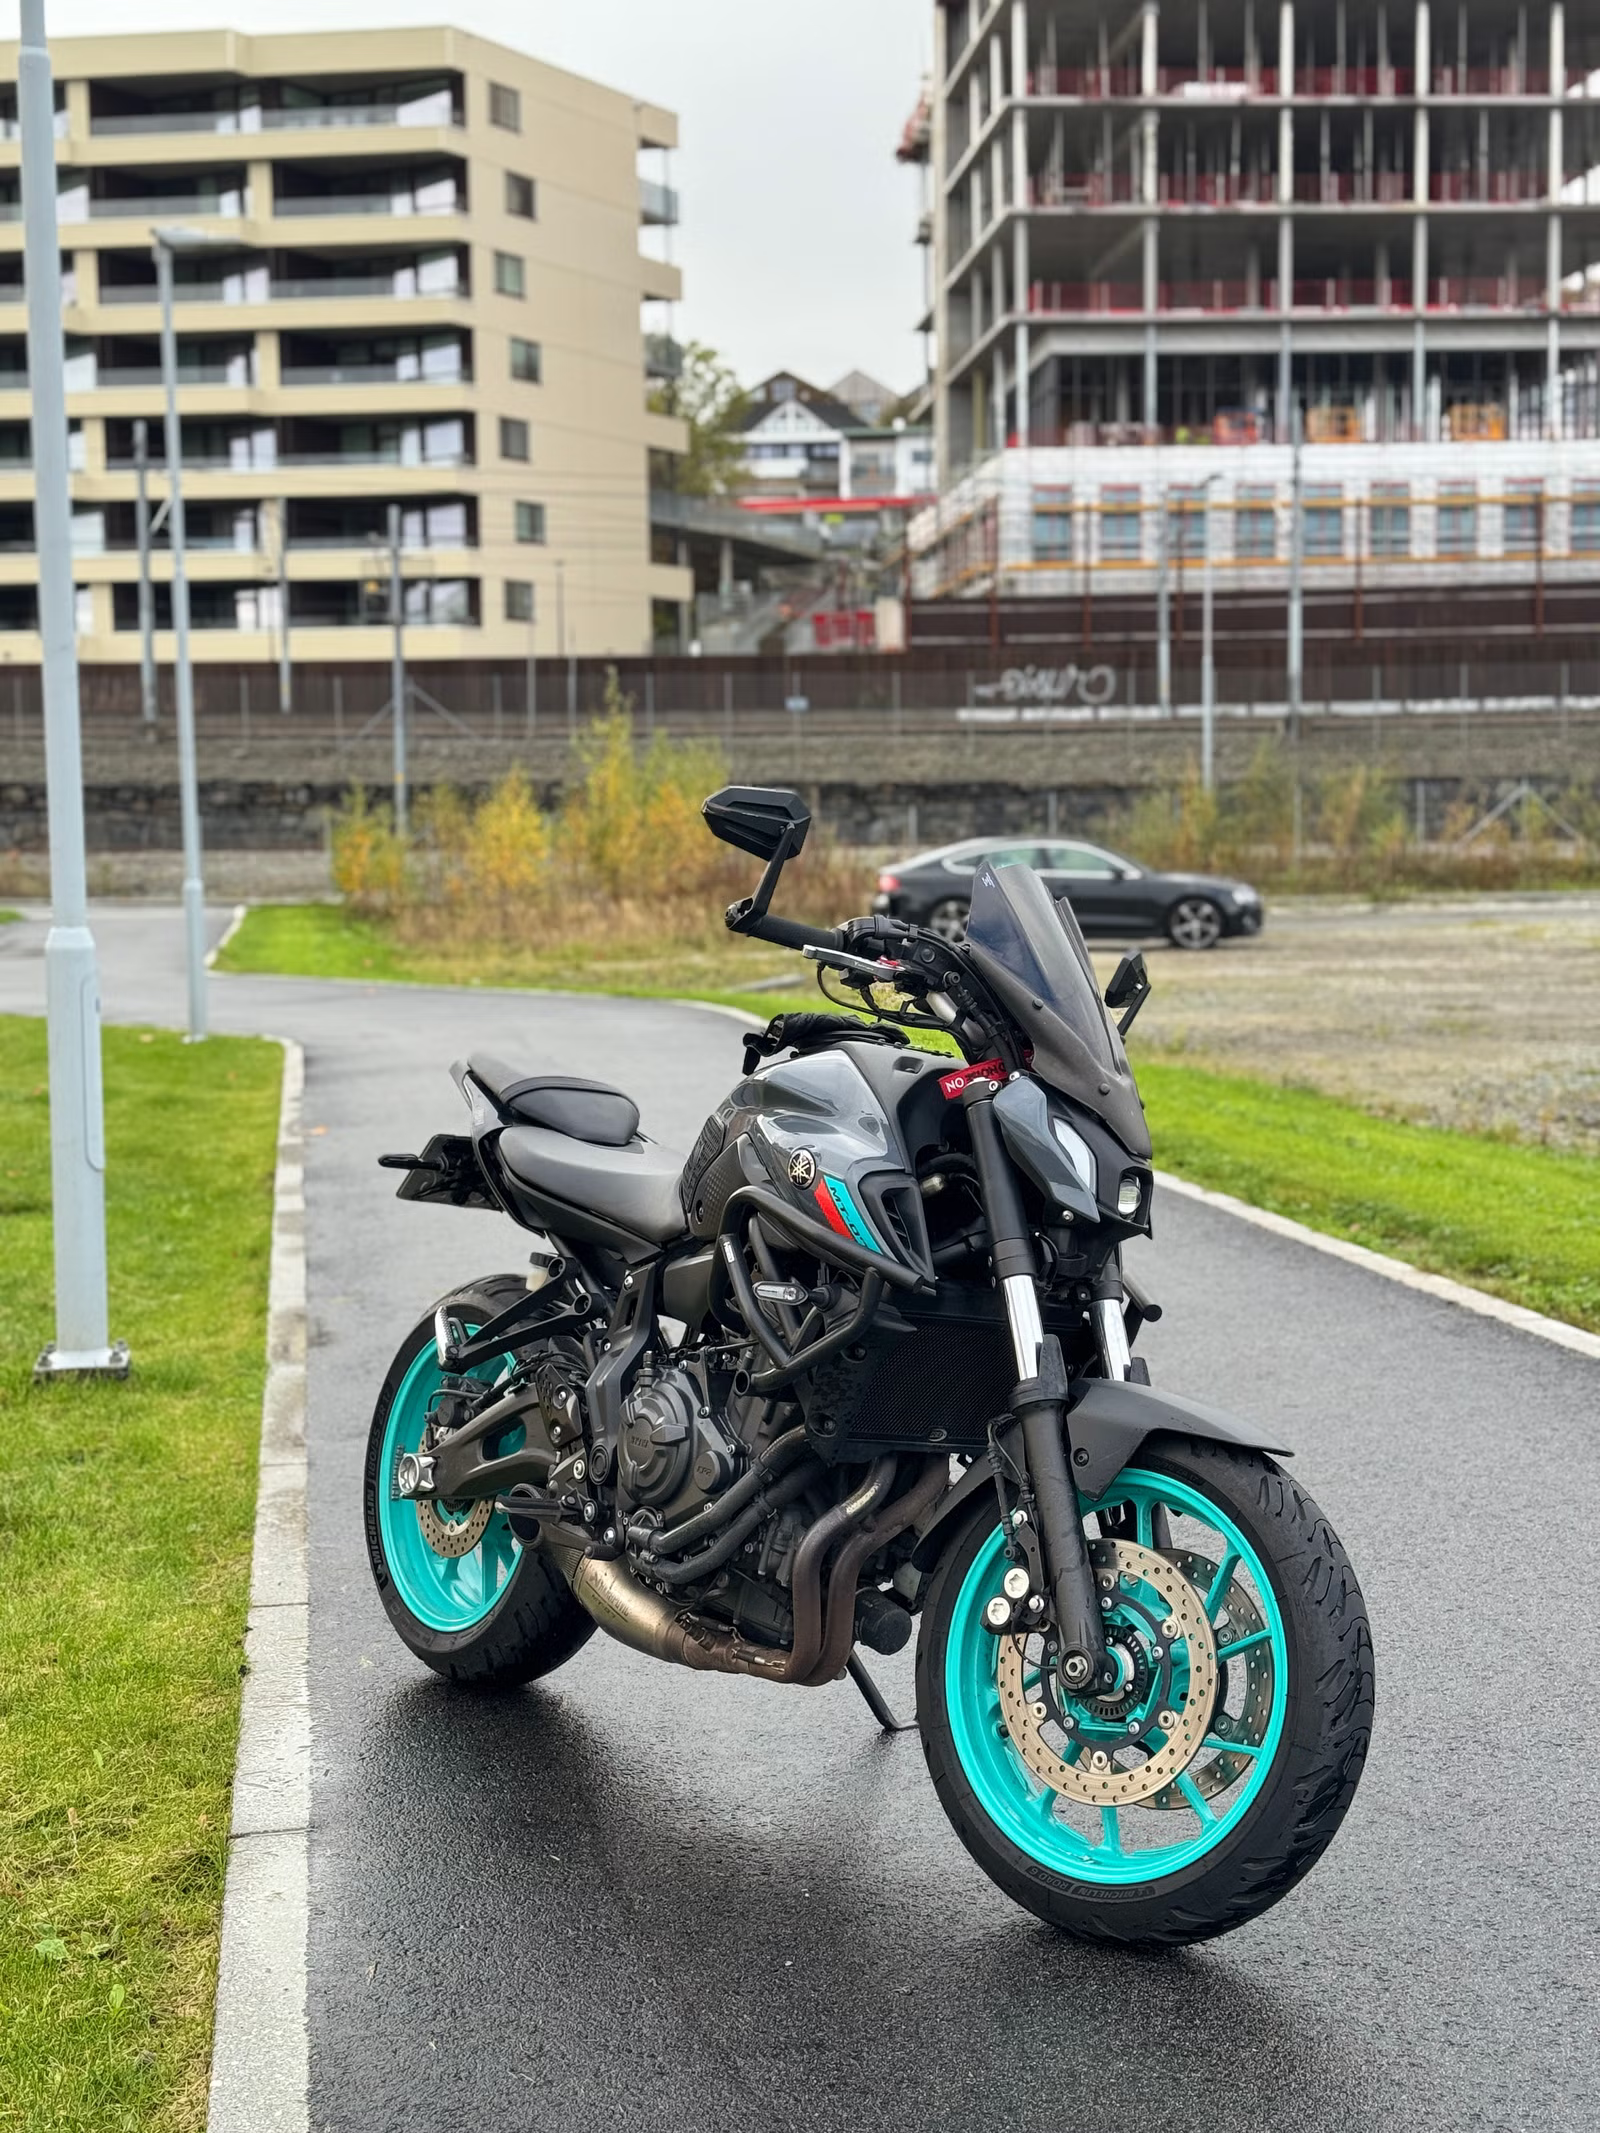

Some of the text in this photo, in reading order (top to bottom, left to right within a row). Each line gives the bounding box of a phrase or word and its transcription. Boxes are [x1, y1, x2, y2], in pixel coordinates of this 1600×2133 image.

[945, 1077, 964, 1093] NO
[366, 1488, 382, 1564] MICHELIN
[1030, 1867, 1136, 1899] MICHELIN ROAD 6
